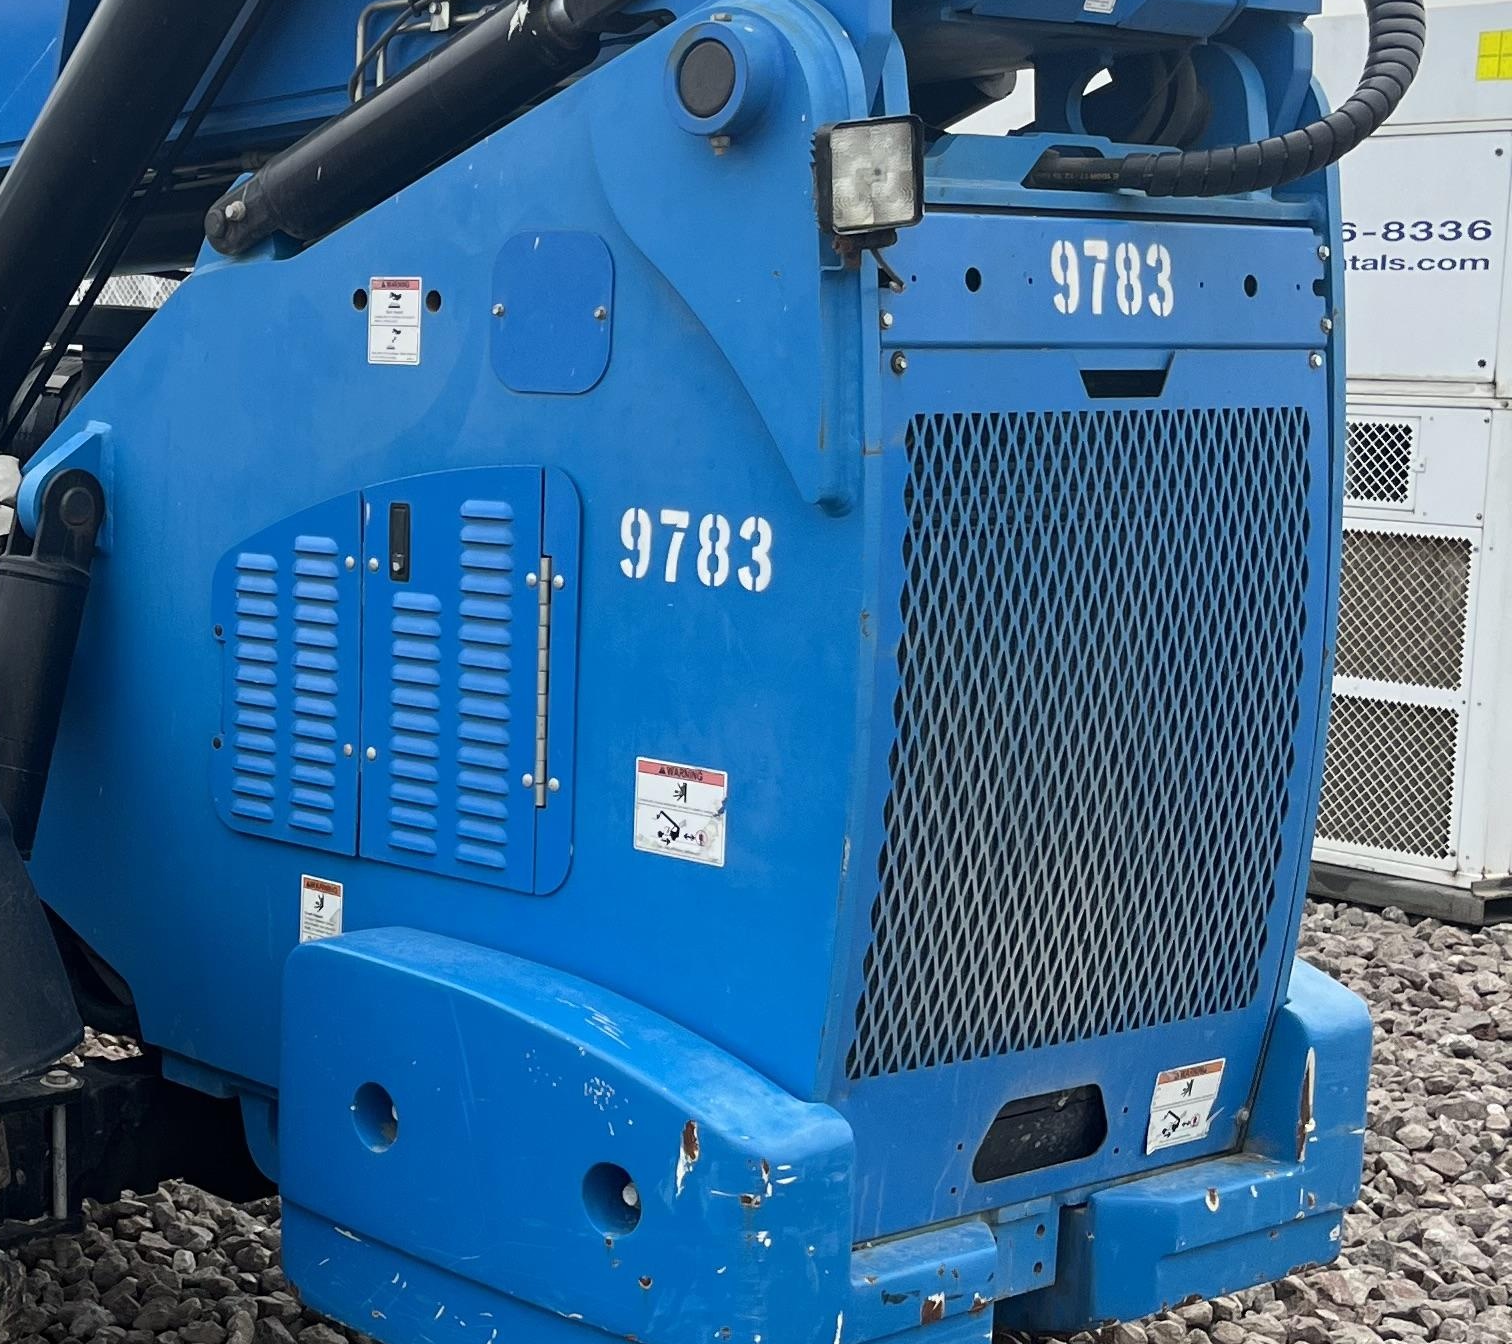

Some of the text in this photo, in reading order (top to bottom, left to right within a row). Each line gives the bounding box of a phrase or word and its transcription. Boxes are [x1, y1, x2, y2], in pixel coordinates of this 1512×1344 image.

[1050, 239, 1174, 317] 9783
[1344, 254, 1490, 271] tals.com
[619, 507, 772, 592] 9783
[667, 766, 704, 781] WARNING
